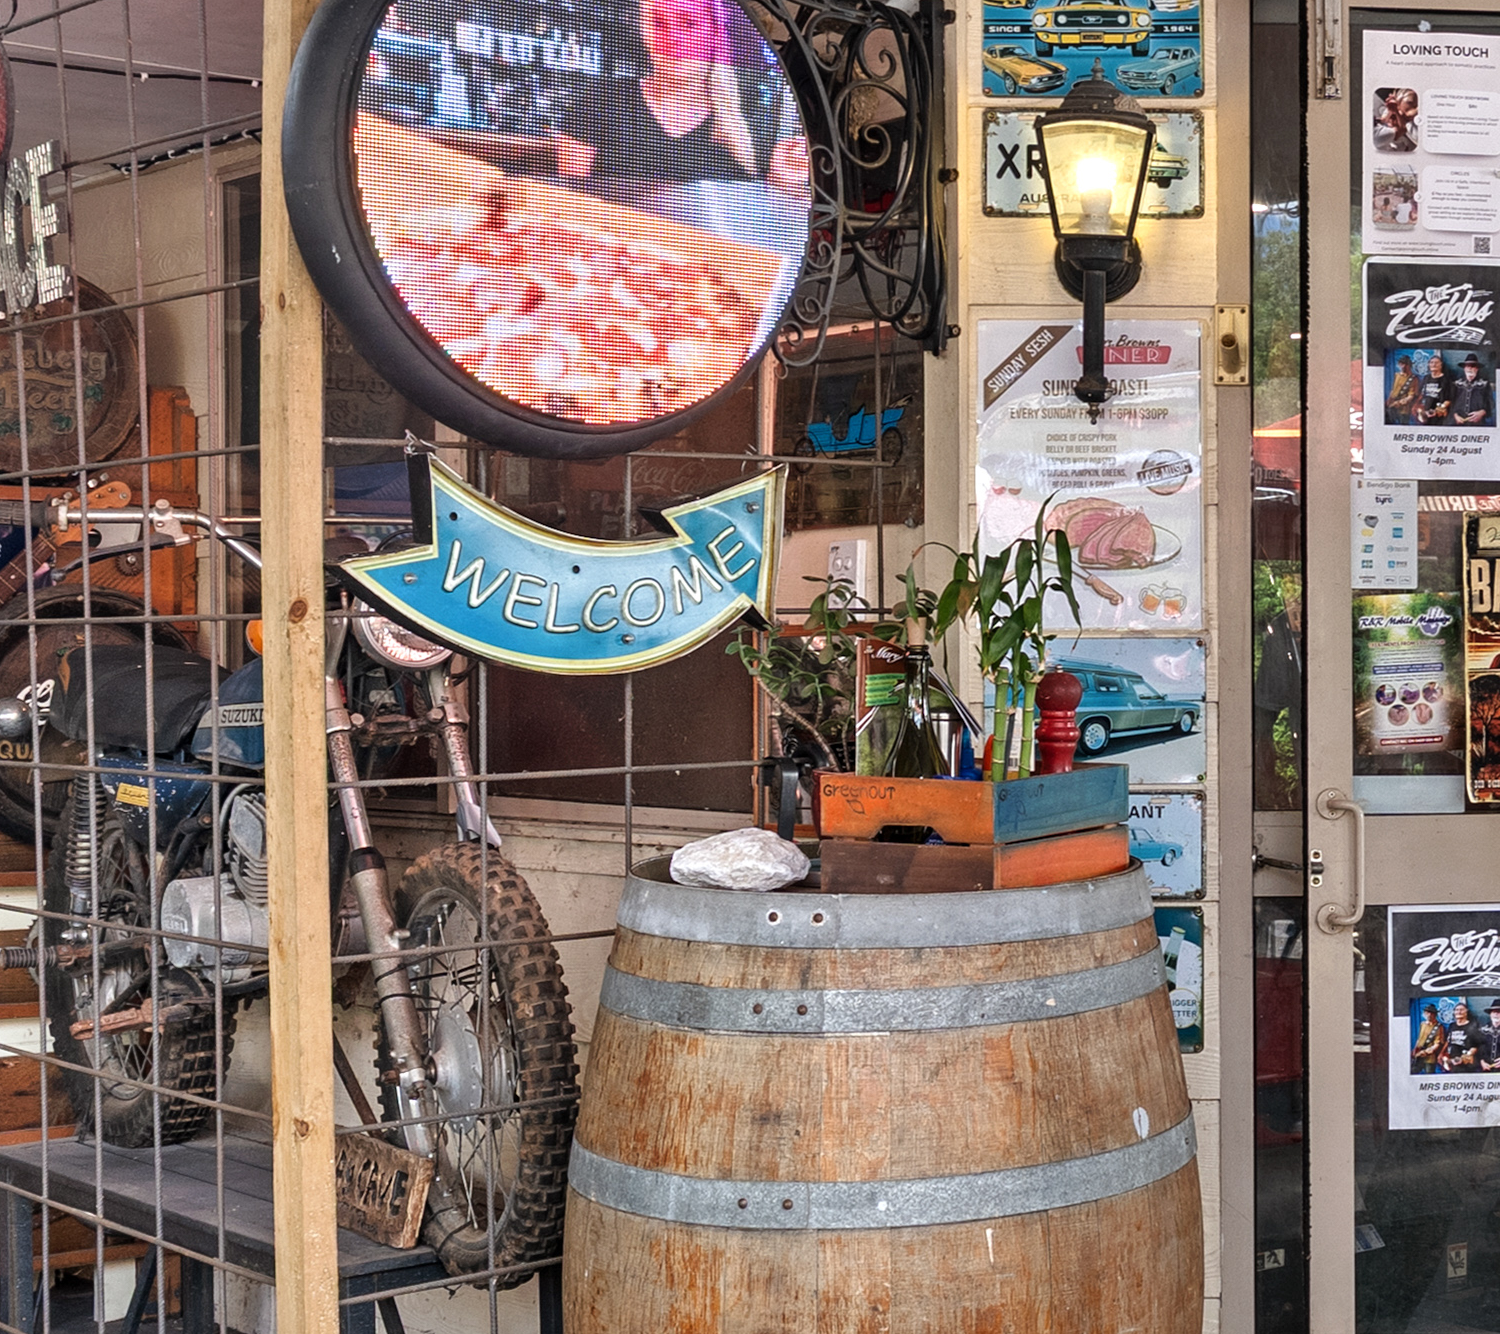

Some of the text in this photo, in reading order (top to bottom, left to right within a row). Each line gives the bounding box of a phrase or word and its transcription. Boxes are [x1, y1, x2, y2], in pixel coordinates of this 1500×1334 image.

[1162, 25, 1194, 33] 1964
[1393, 44, 1490, 59] LOVING TOUCH
[1428, 289, 1445, 303] THE
[1384, 286, 1495, 337] Freddys
[1116, 334, 1161, 348] Browns
[986, 328, 1055, 394] SUNDAY SESH
[2, 381, 77, 411] Beer
[1010, 408, 1040, 420] EVERY
[1041, 408, 1077, 420] SUNDAY
[1393, 433, 1491, 444] MRS BROWNS DINER
[1401, 444, 1483, 457] Sunday 24 August
[1366, 481, 1412, 491] Bendigo Bank
[1374, 495, 1394, 505] tyro
[442, 525, 757, 634] WELCOME
[1385, 616, 1414, 627] Mobile
[220, 709, 263, 725] SUZUKI
[1452, 937, 1470, 949] THE
[1171, 999, 1197, 1008] IGGER
[1418, 1081, 1441, 1091] MRS
[1442, 1081, 1485, 1091] BROWNS
[1426, 1093, 1461, 1104] Sunday
[1462, 1093, 1473, 1102] 24
[1453, 1104, 1483, 1114] 1-4pm.
